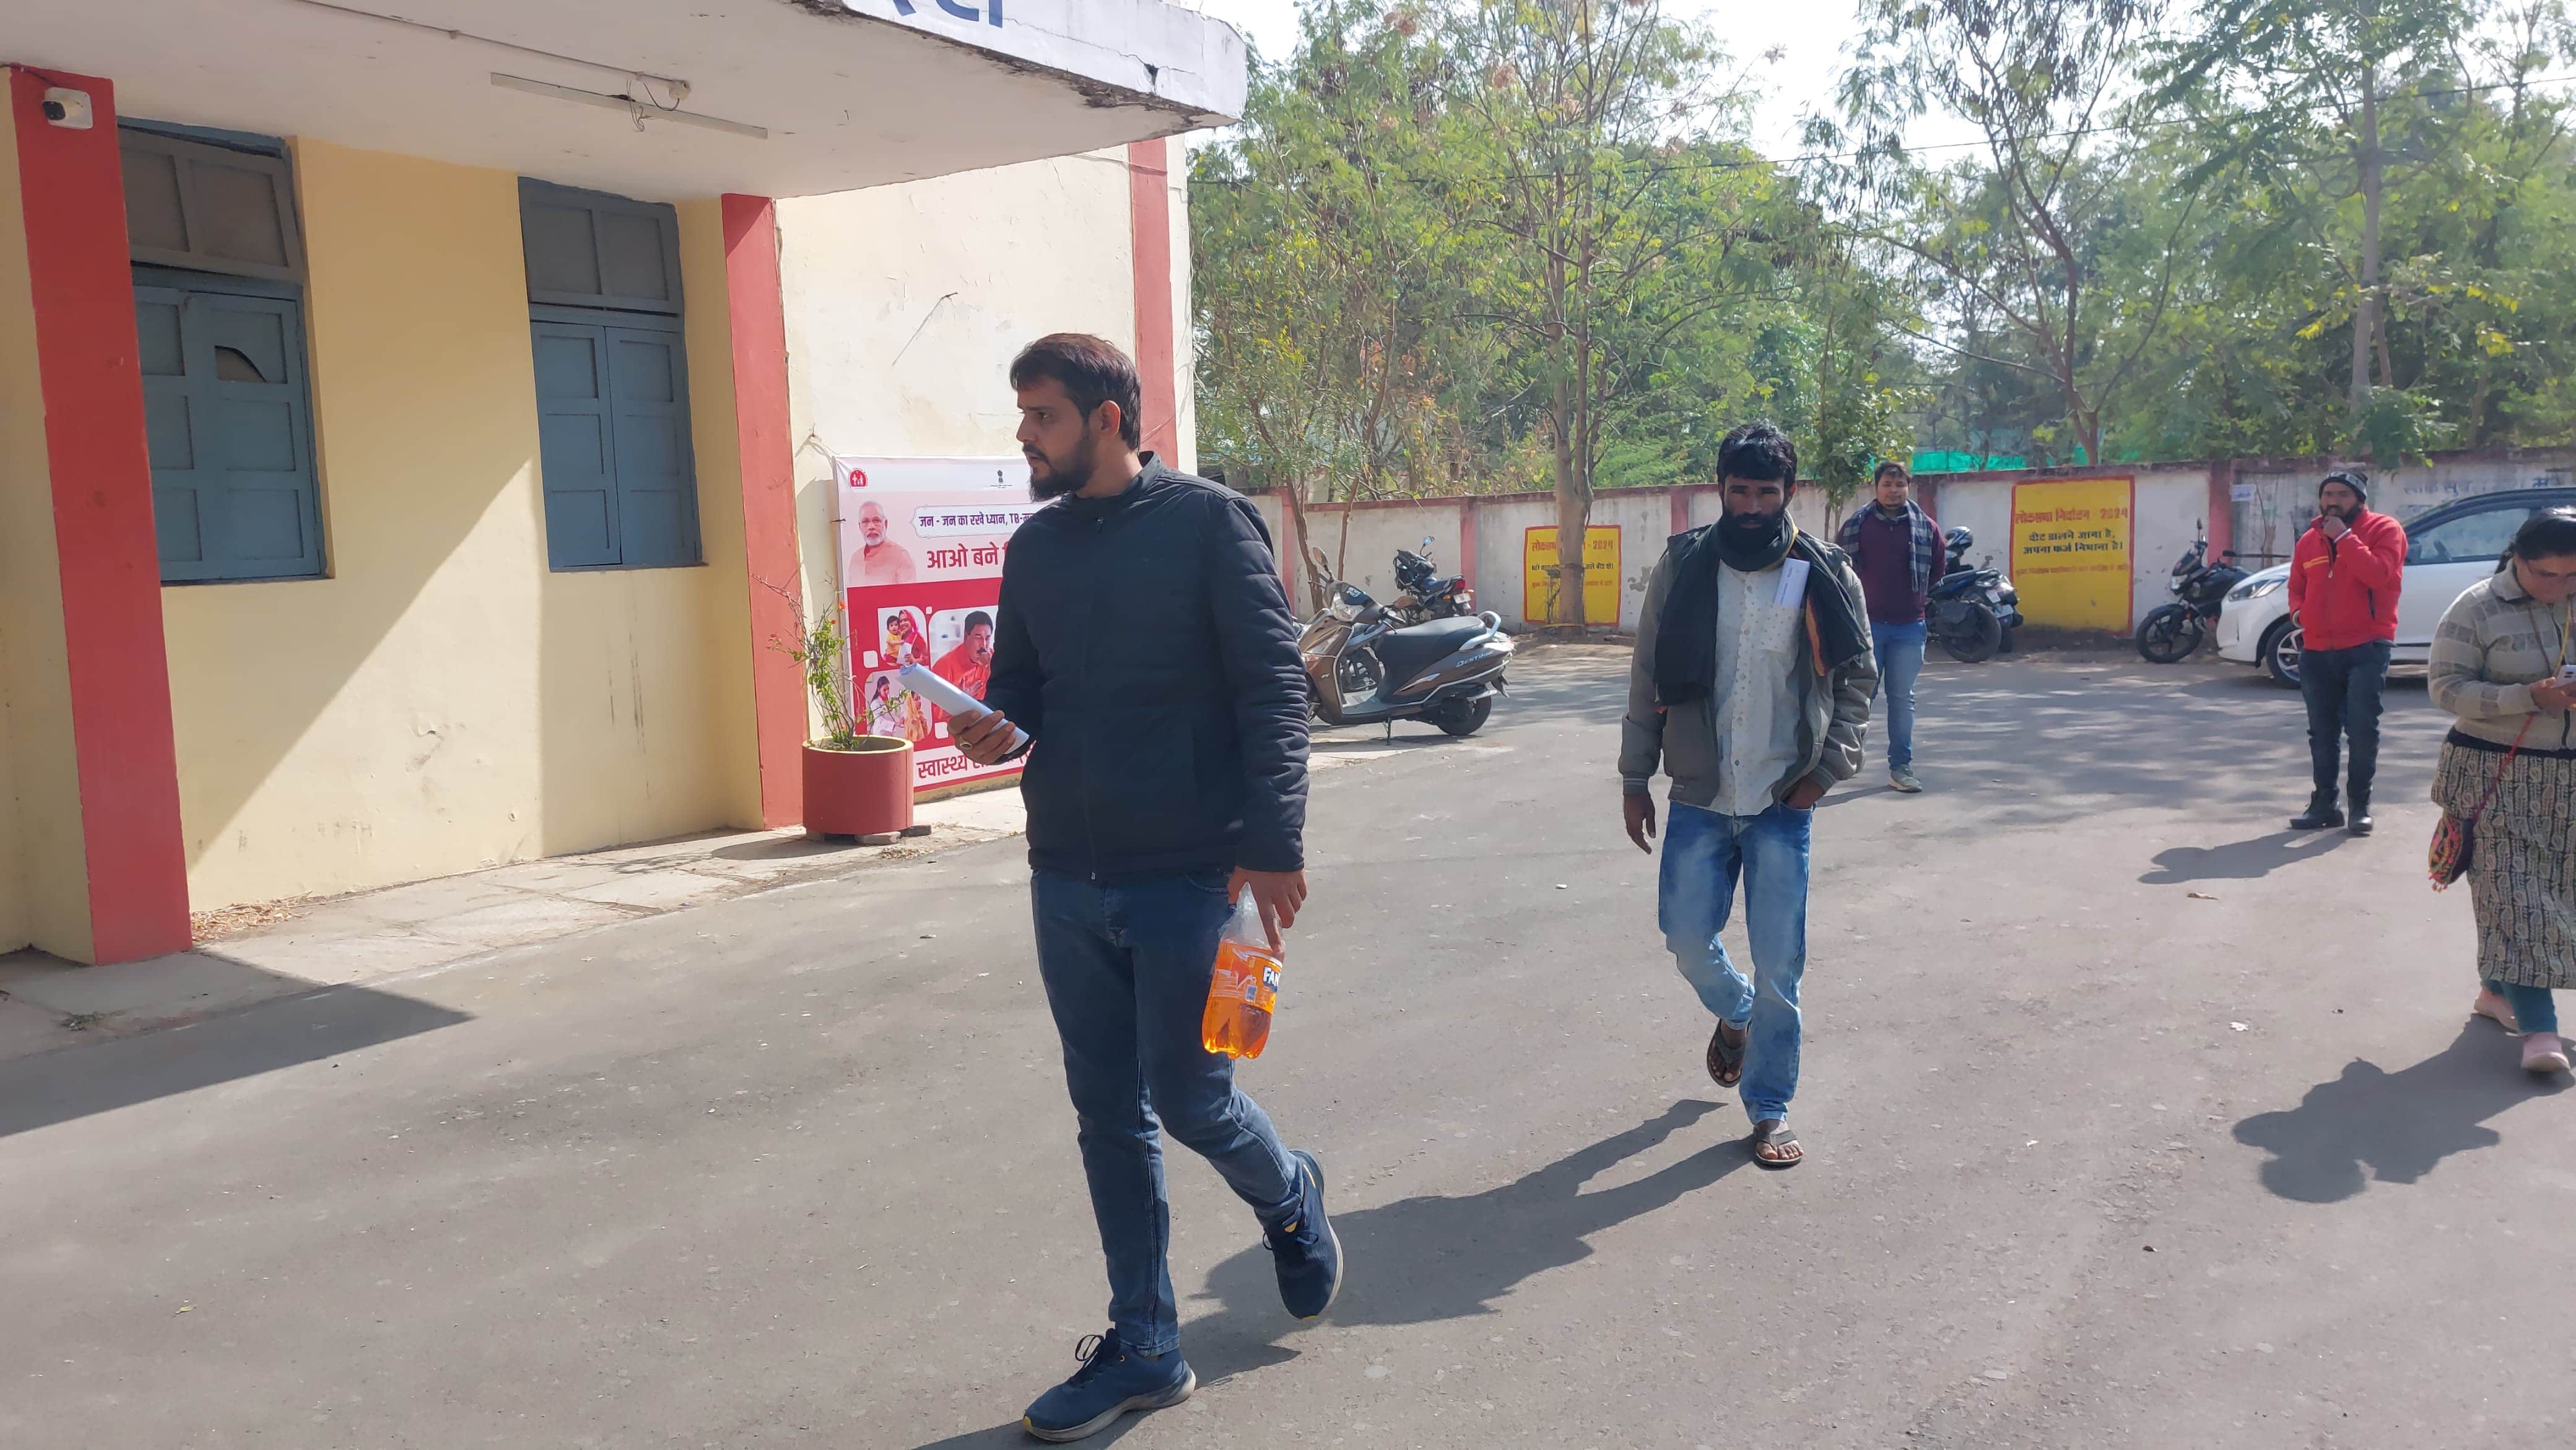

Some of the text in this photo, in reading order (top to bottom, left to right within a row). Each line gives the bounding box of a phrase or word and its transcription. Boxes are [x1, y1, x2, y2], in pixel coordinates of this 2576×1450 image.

[919, 516, 934, 527] जन
[941, 515, 956, 526] जन
[957, 514, 968, 526] का
[969, 511, 985, 525] रखे
[986, 513, 1007, 526] ध्यान,
[926, 543, 968, 568] आओ
[971, 541, 999, 566] बने
[916, 755, 968, 779] स्वास्थ्य
